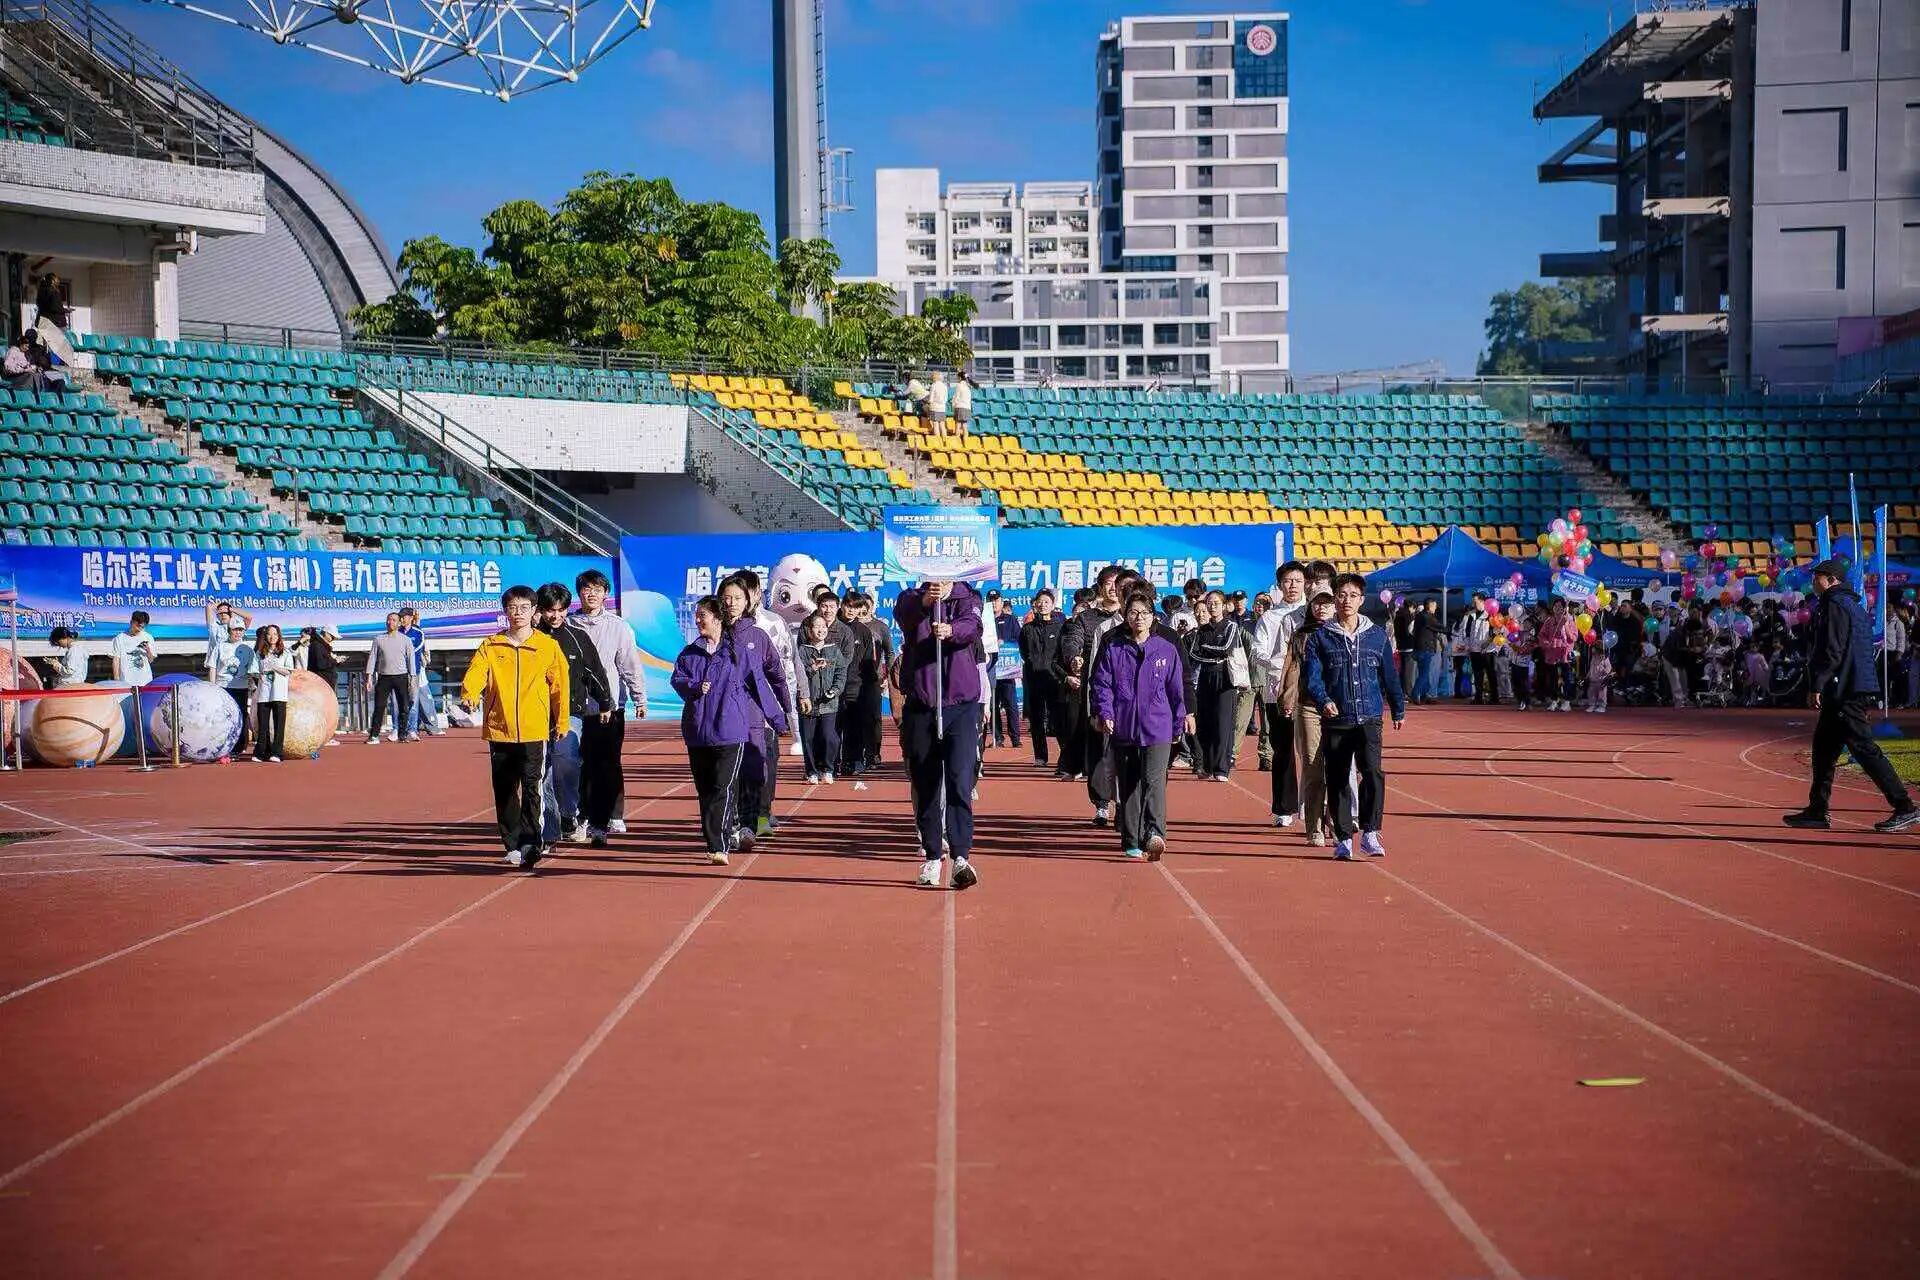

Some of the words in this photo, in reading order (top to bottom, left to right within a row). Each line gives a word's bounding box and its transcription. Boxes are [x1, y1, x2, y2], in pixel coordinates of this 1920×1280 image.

[902, 535, 980, 557] 清北联队
[83, 592, 104, 606] The
[105, 593, 125, 606] 9th
[126, 594, 158, 607] Track
[159, 594, 180, 607] and
[181, 594, 206, 608] Field
[243, 595, 285, 611] Meeting
[287, 596, 298, 609] of
[298, 596, 333, 609] Harbin
[334, 597, 375, 609] Institute
[377, 597, 387, 609] of
[387, 597, 445, 612] Technology
